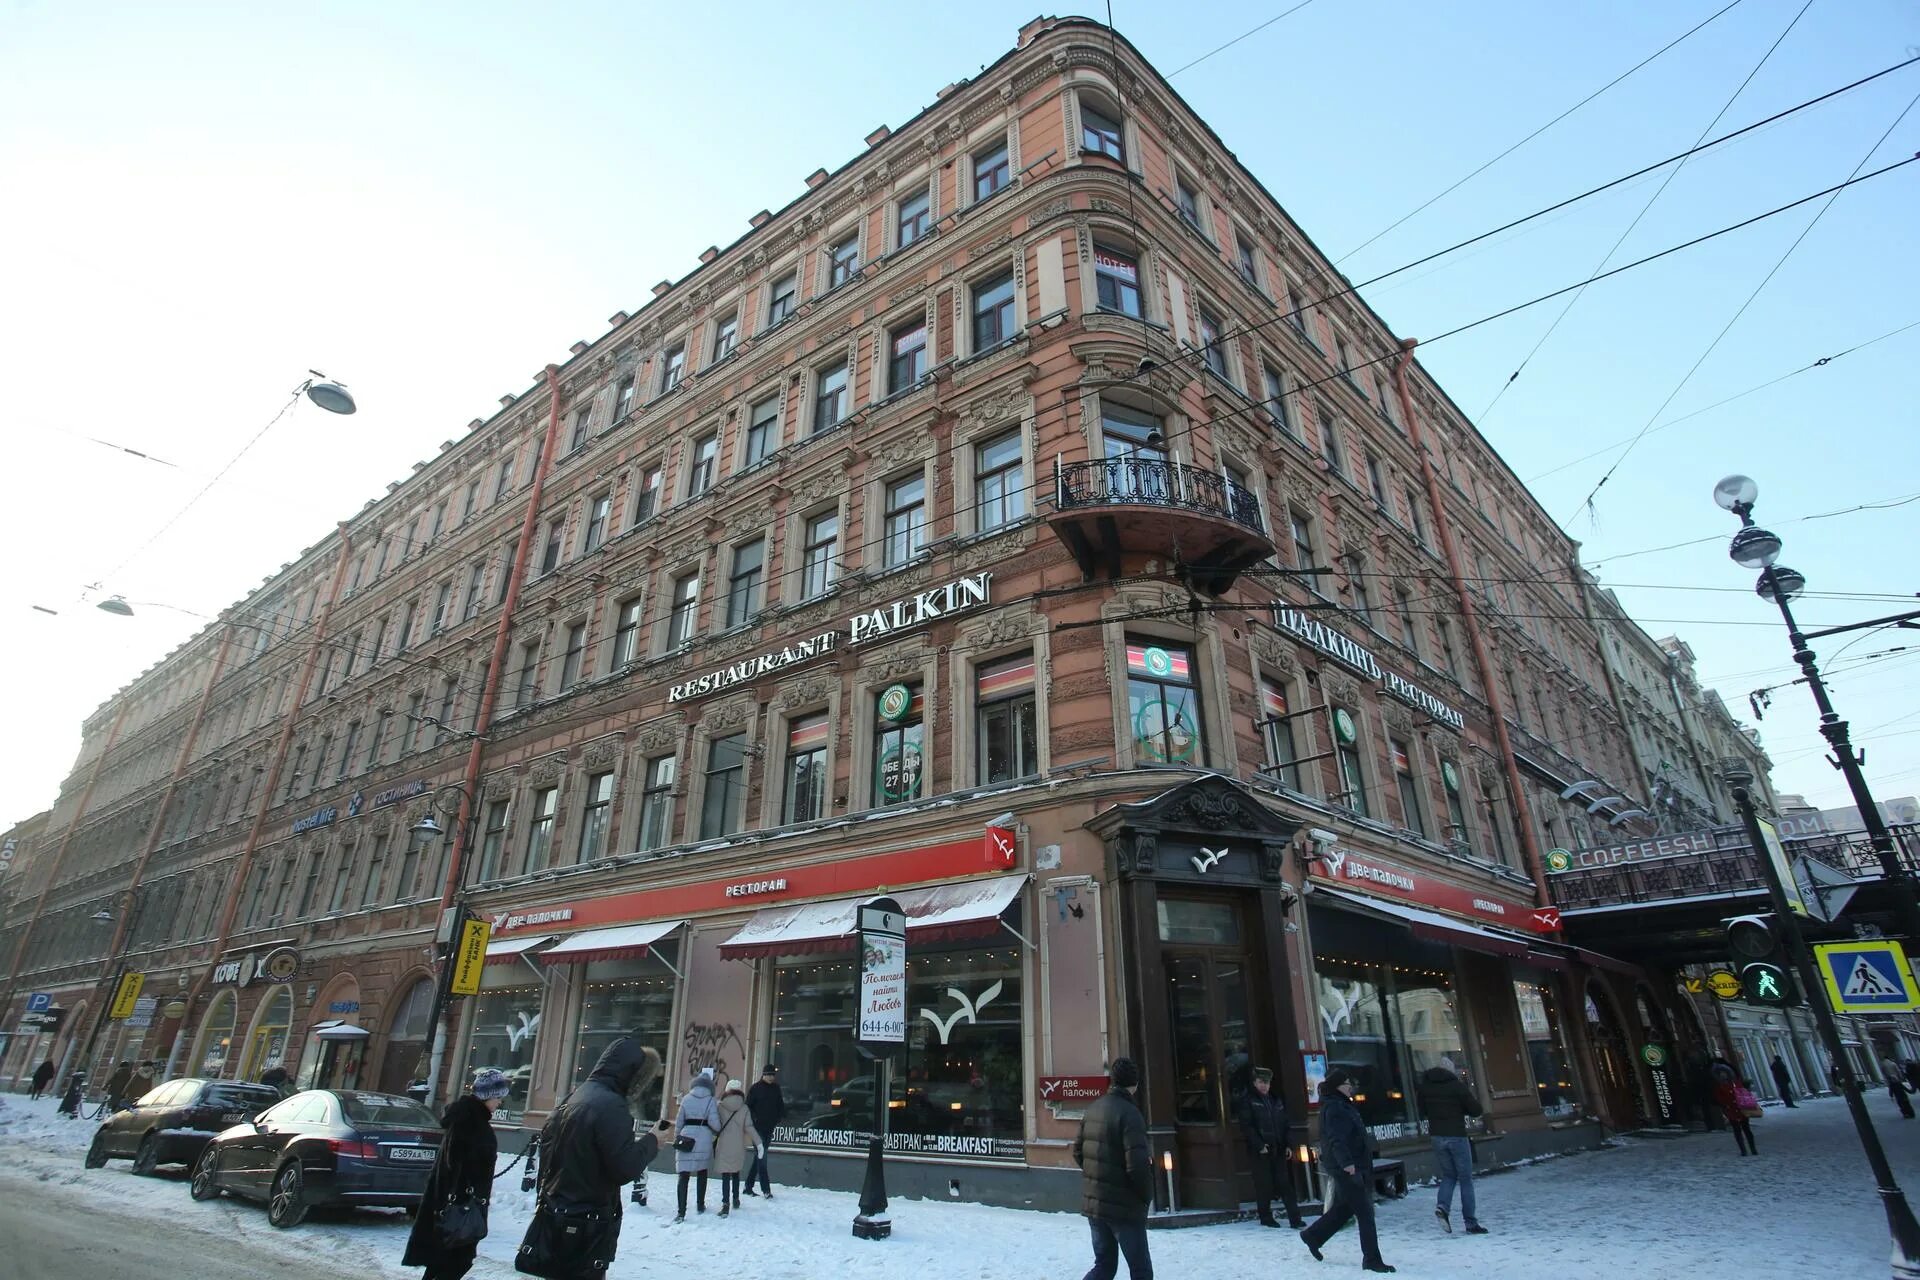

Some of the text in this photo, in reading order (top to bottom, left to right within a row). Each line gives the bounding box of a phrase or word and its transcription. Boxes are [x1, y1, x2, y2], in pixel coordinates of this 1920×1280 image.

[1095, 253, 1136, 278] HOTEL
[667, 570, 993, 703] RESTAURANT PALKIN
[1271, 599, 1382, 681] ПАЛКИНЪ
[1384, 671, 1465, 730] РЕСТОРАН
[724, 879, 787, 897] РЕСТОРАН
[1371, 868, 1415, 892] палочки
[862, 1020, 904, 1034] 644-6-007
[1062, 1080, 1079, 1088] две
[1062, 1089, 1101, 1097] палочки
[807, 1128, 854, 1146] BREAKFAST
[1373, 1123, 1402, 1141] BREAKFAST
[937, 1135, 993, 1155] BREAKFAST
